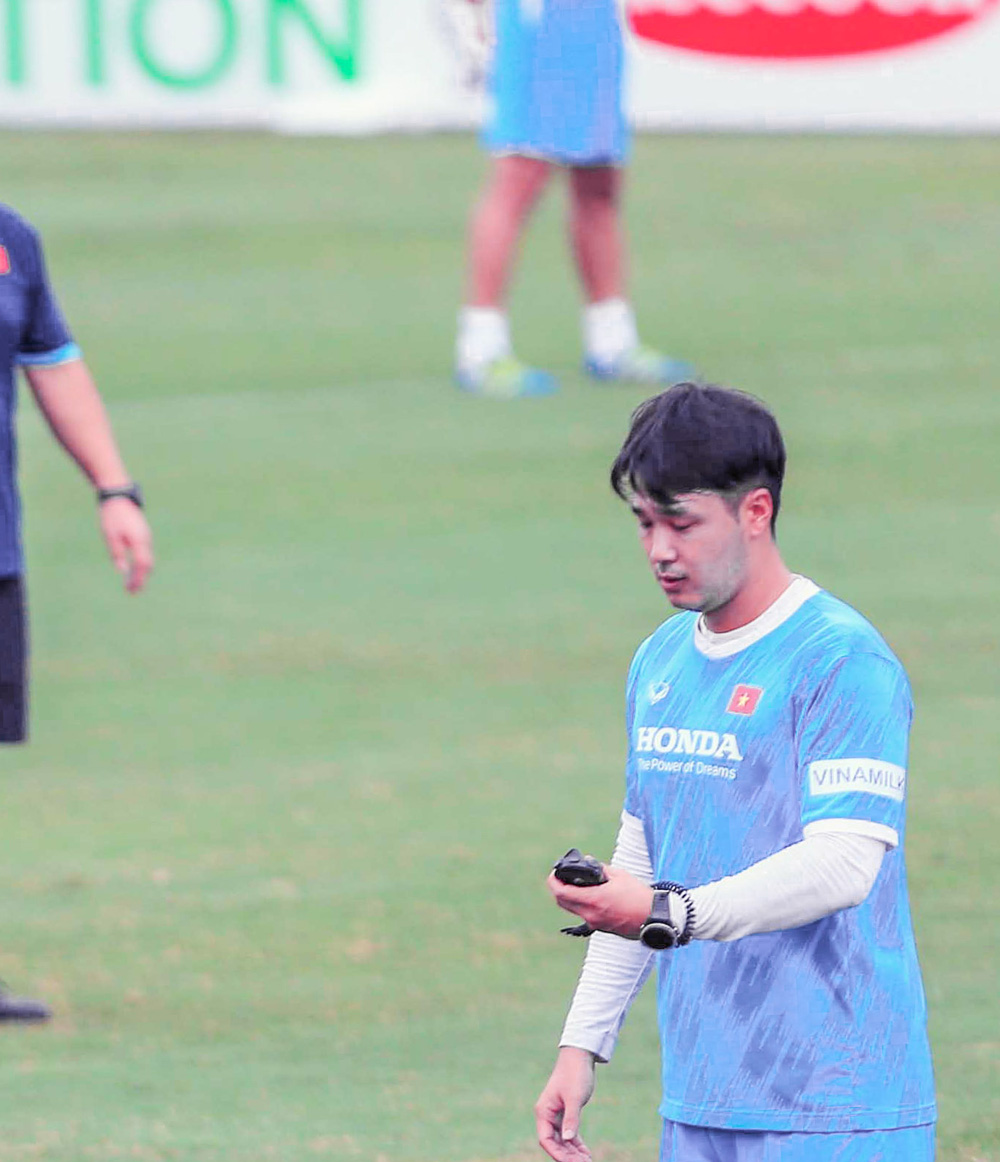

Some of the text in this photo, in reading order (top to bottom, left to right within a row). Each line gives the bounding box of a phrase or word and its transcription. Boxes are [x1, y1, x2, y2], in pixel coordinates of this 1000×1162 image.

[636, 726, 744, 761] HONDA
[650, 757, 682, 773] Power
[683, 760, 695, 773] of
[696, 761, 738, 780] Dreams
